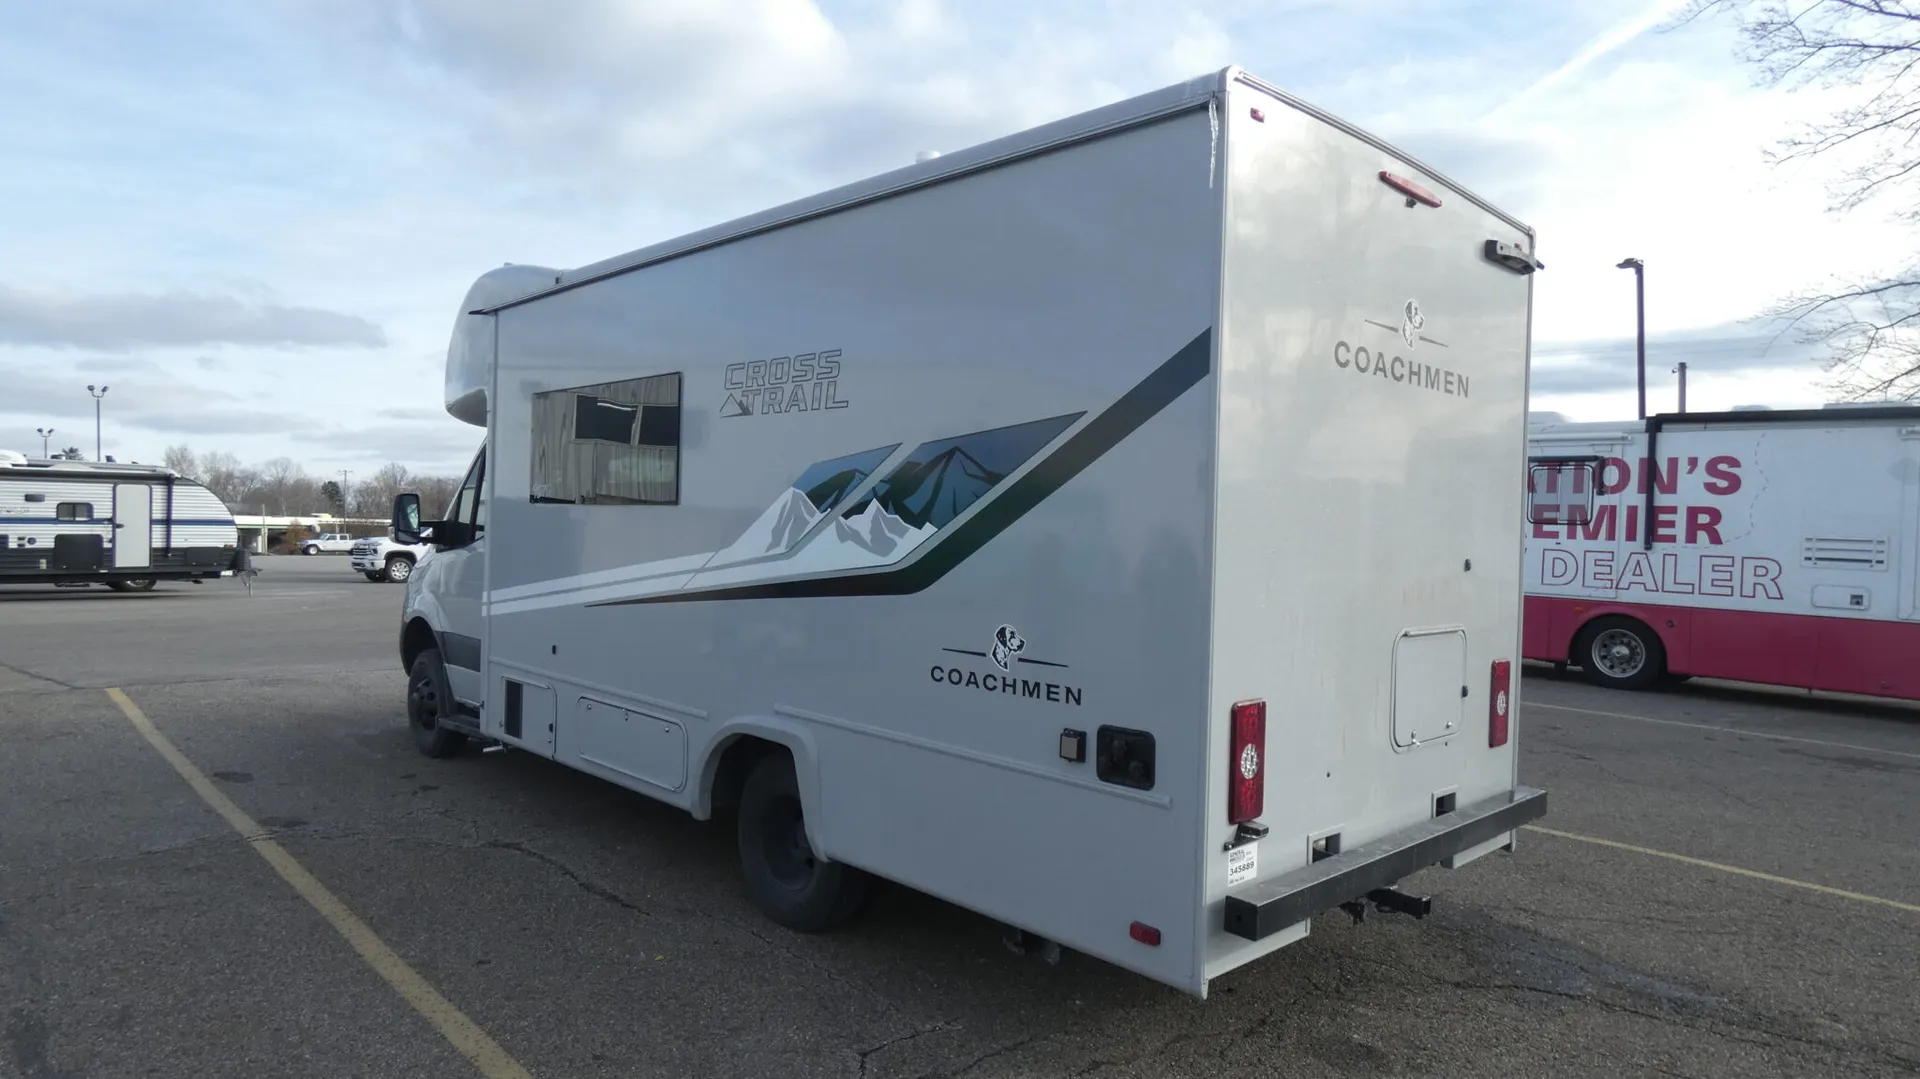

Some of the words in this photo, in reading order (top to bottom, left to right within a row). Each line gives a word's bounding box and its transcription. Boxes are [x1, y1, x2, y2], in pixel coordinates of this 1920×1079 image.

[724, 348, 842, 391] CROSS
[1334, 340, 1469, 398] COACHMEN
[741, 381, 849, 416] TRAIL
[1527, 455, 1743, 496] TION'S
[1541, 548, 1784, 600] DEALER
[930, 665, 1082, 706] COACHMEN
